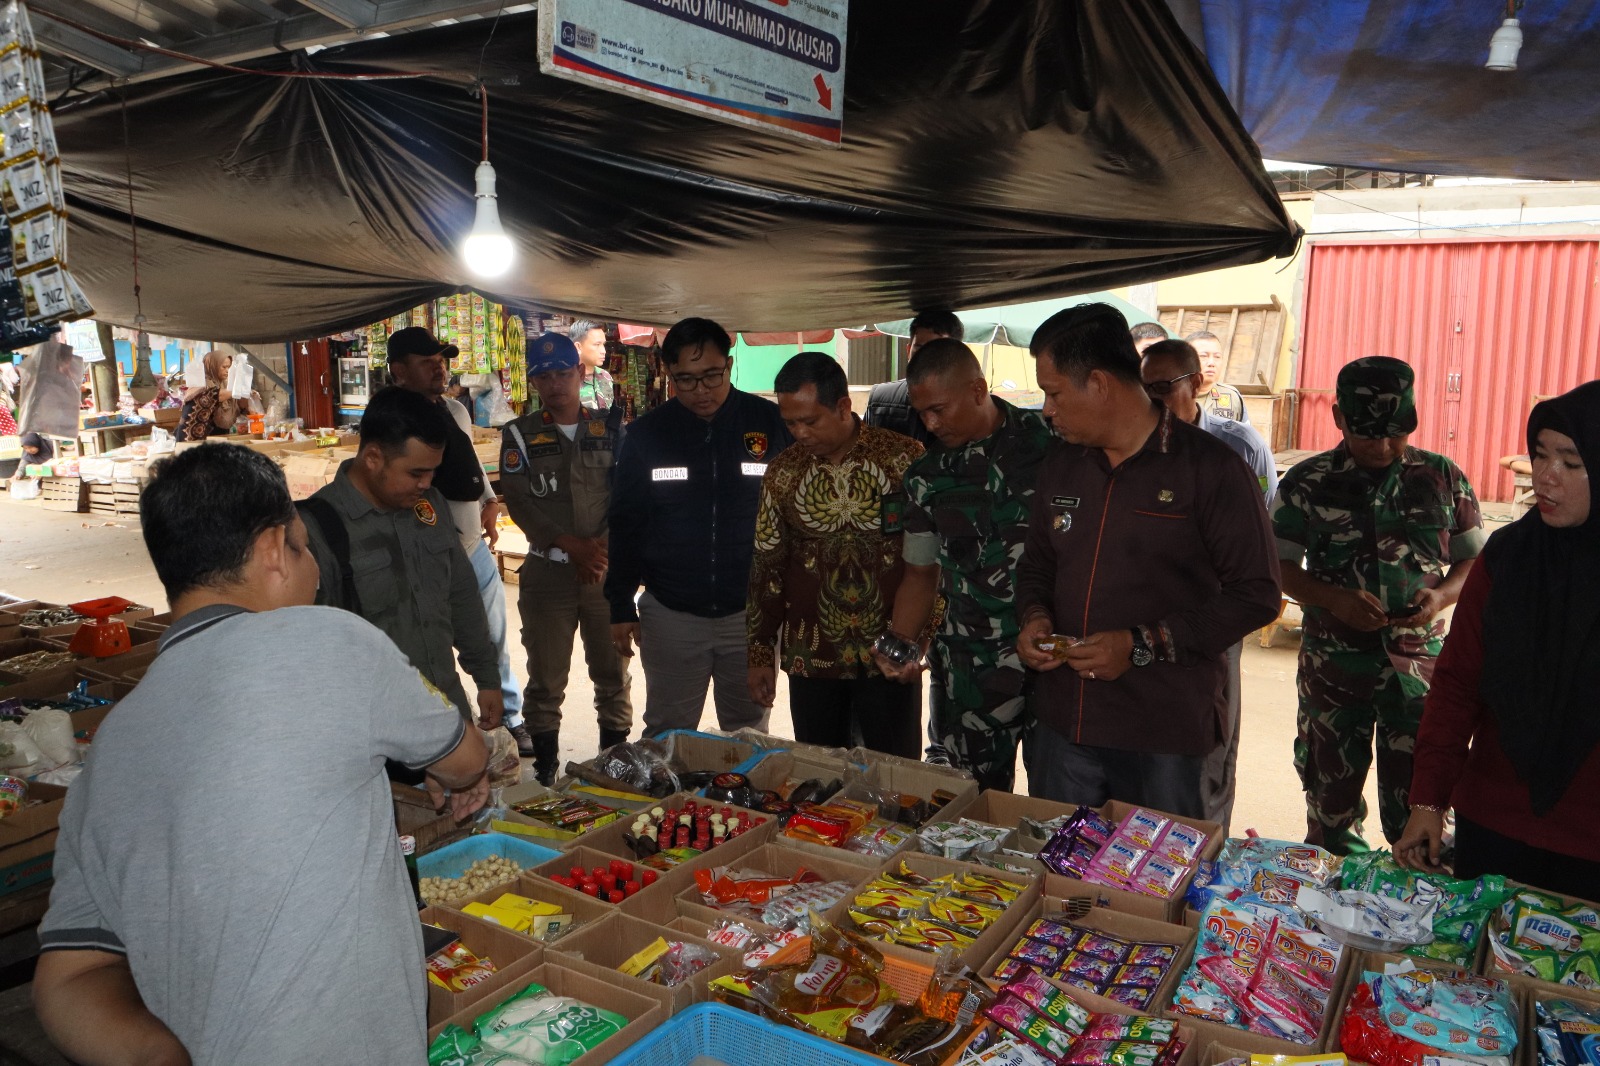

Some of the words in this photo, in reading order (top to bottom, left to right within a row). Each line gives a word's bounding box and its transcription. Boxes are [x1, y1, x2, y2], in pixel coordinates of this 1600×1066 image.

[817, 4, 830, 17] BANK
[831, 11, 839, 20] BRI
[704, 0, 786, 47] MUHAMMAD
[788, 27, 834, 65] KAUSAR
[601, 37, 644, 56] www.bri.co.id
[654, 468, 686, 479] BONDAN
[1276, 934, 1336, 974] Daia
[550, 1008, 594, 1040] PSM
